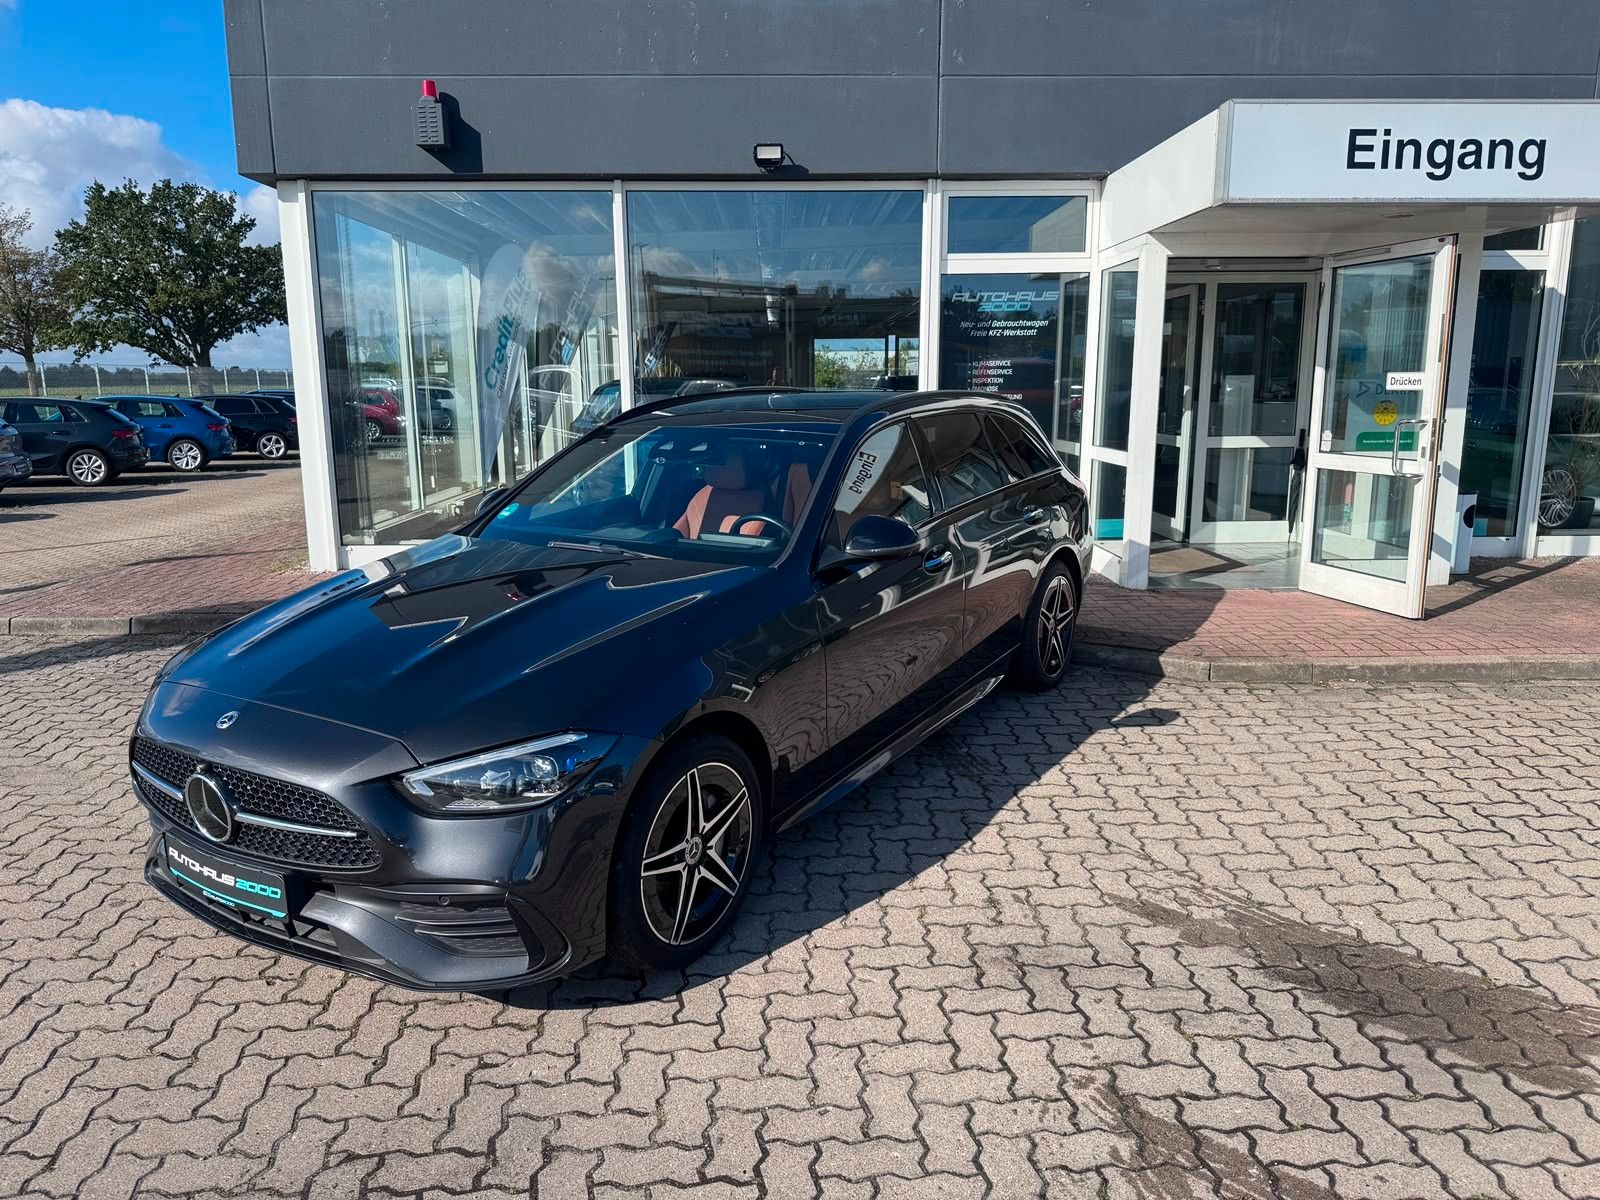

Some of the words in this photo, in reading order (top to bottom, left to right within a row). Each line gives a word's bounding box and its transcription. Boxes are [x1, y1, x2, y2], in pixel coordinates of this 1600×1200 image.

[1347, 128, 1547, 181] Eingang
[952, 291, 1060, 302] AUTOHAUS
[977, 302, 1032, 312] 2000
[991, 320, 1049, 328] Gebrauchtwagen
[988, 329, 1038, 337] KFZ-Werkstatt
[1390, 377, 1422, 386] Drücken
